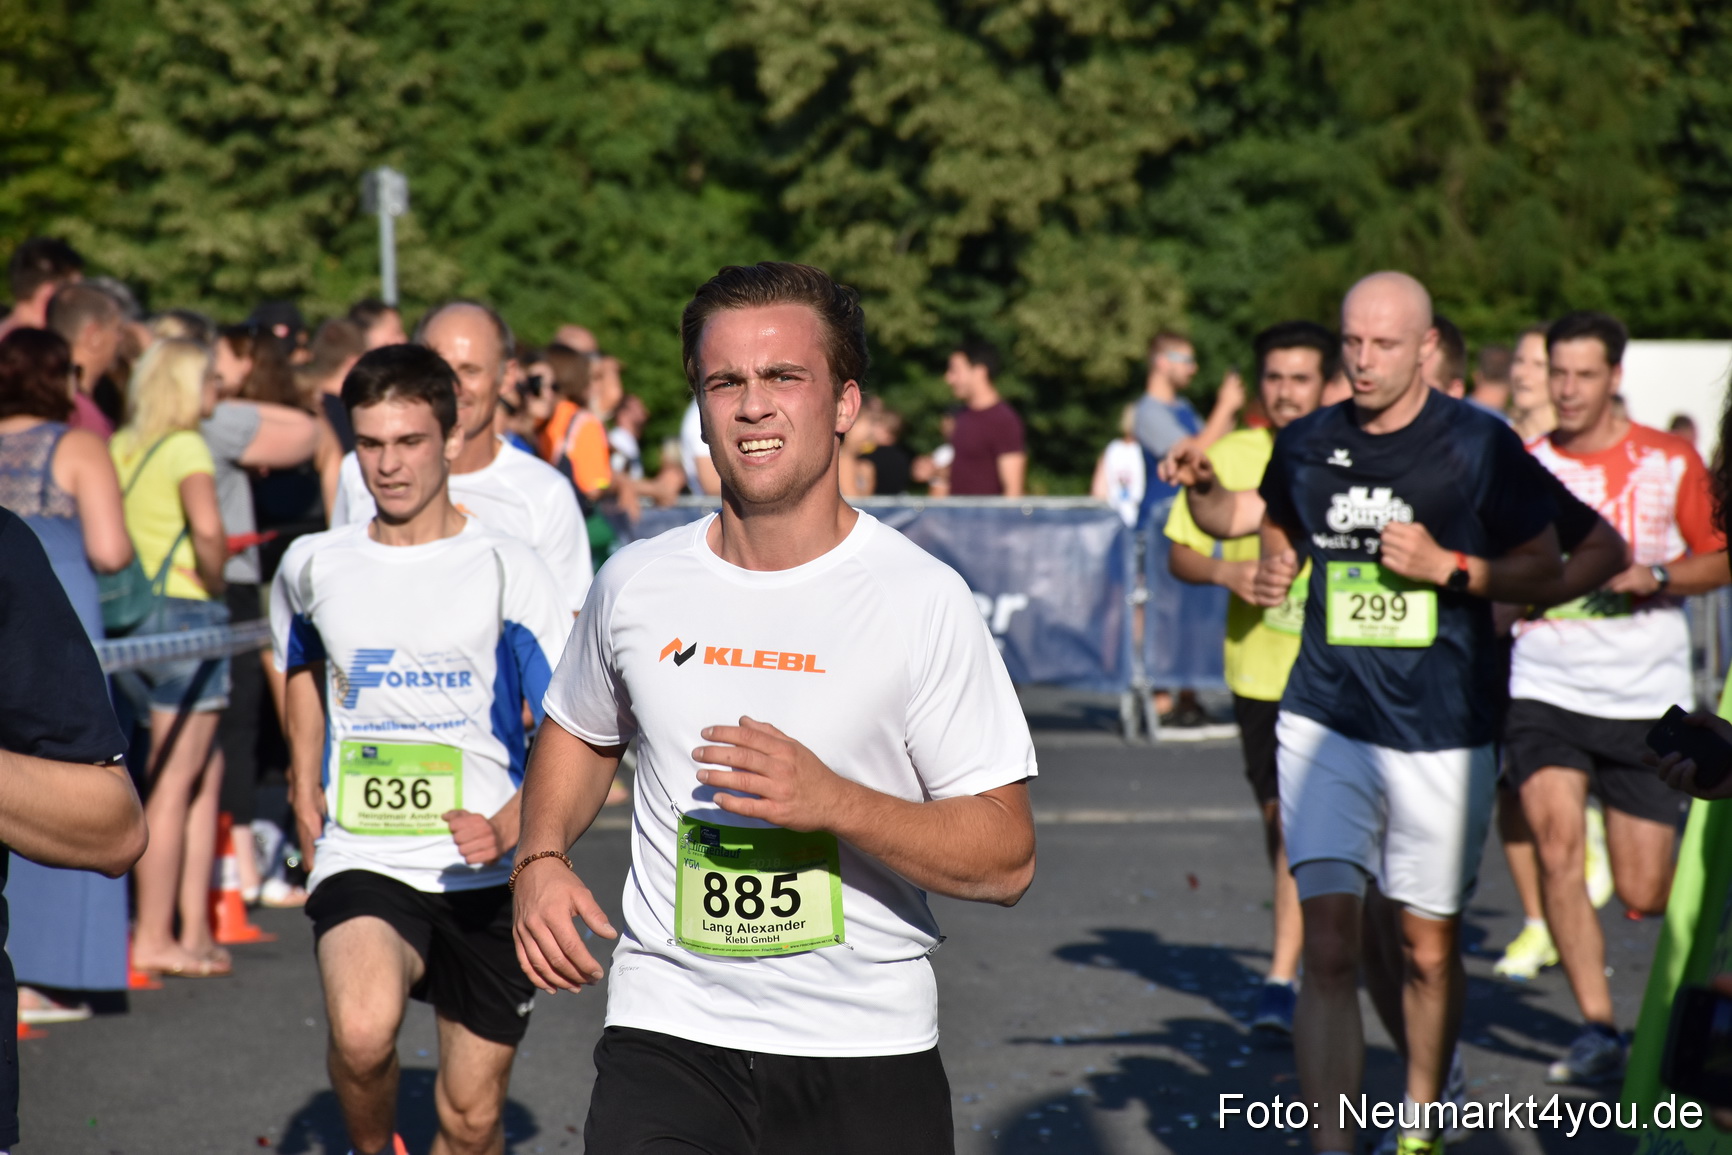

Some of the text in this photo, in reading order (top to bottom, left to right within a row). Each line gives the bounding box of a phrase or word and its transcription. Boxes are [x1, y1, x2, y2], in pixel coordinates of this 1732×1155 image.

[1350, 594, 1408, 621] 299
[703, 645, 826, 673] KLEBL
[343, 649, 472, 709] FORSTER
[364, 777, 432, 809] 636
[703, 872, 801, 920] 885
[702, 919, 806, 935] Lang Alexander
[725, 935, 780, 944] Klebl GmbH
